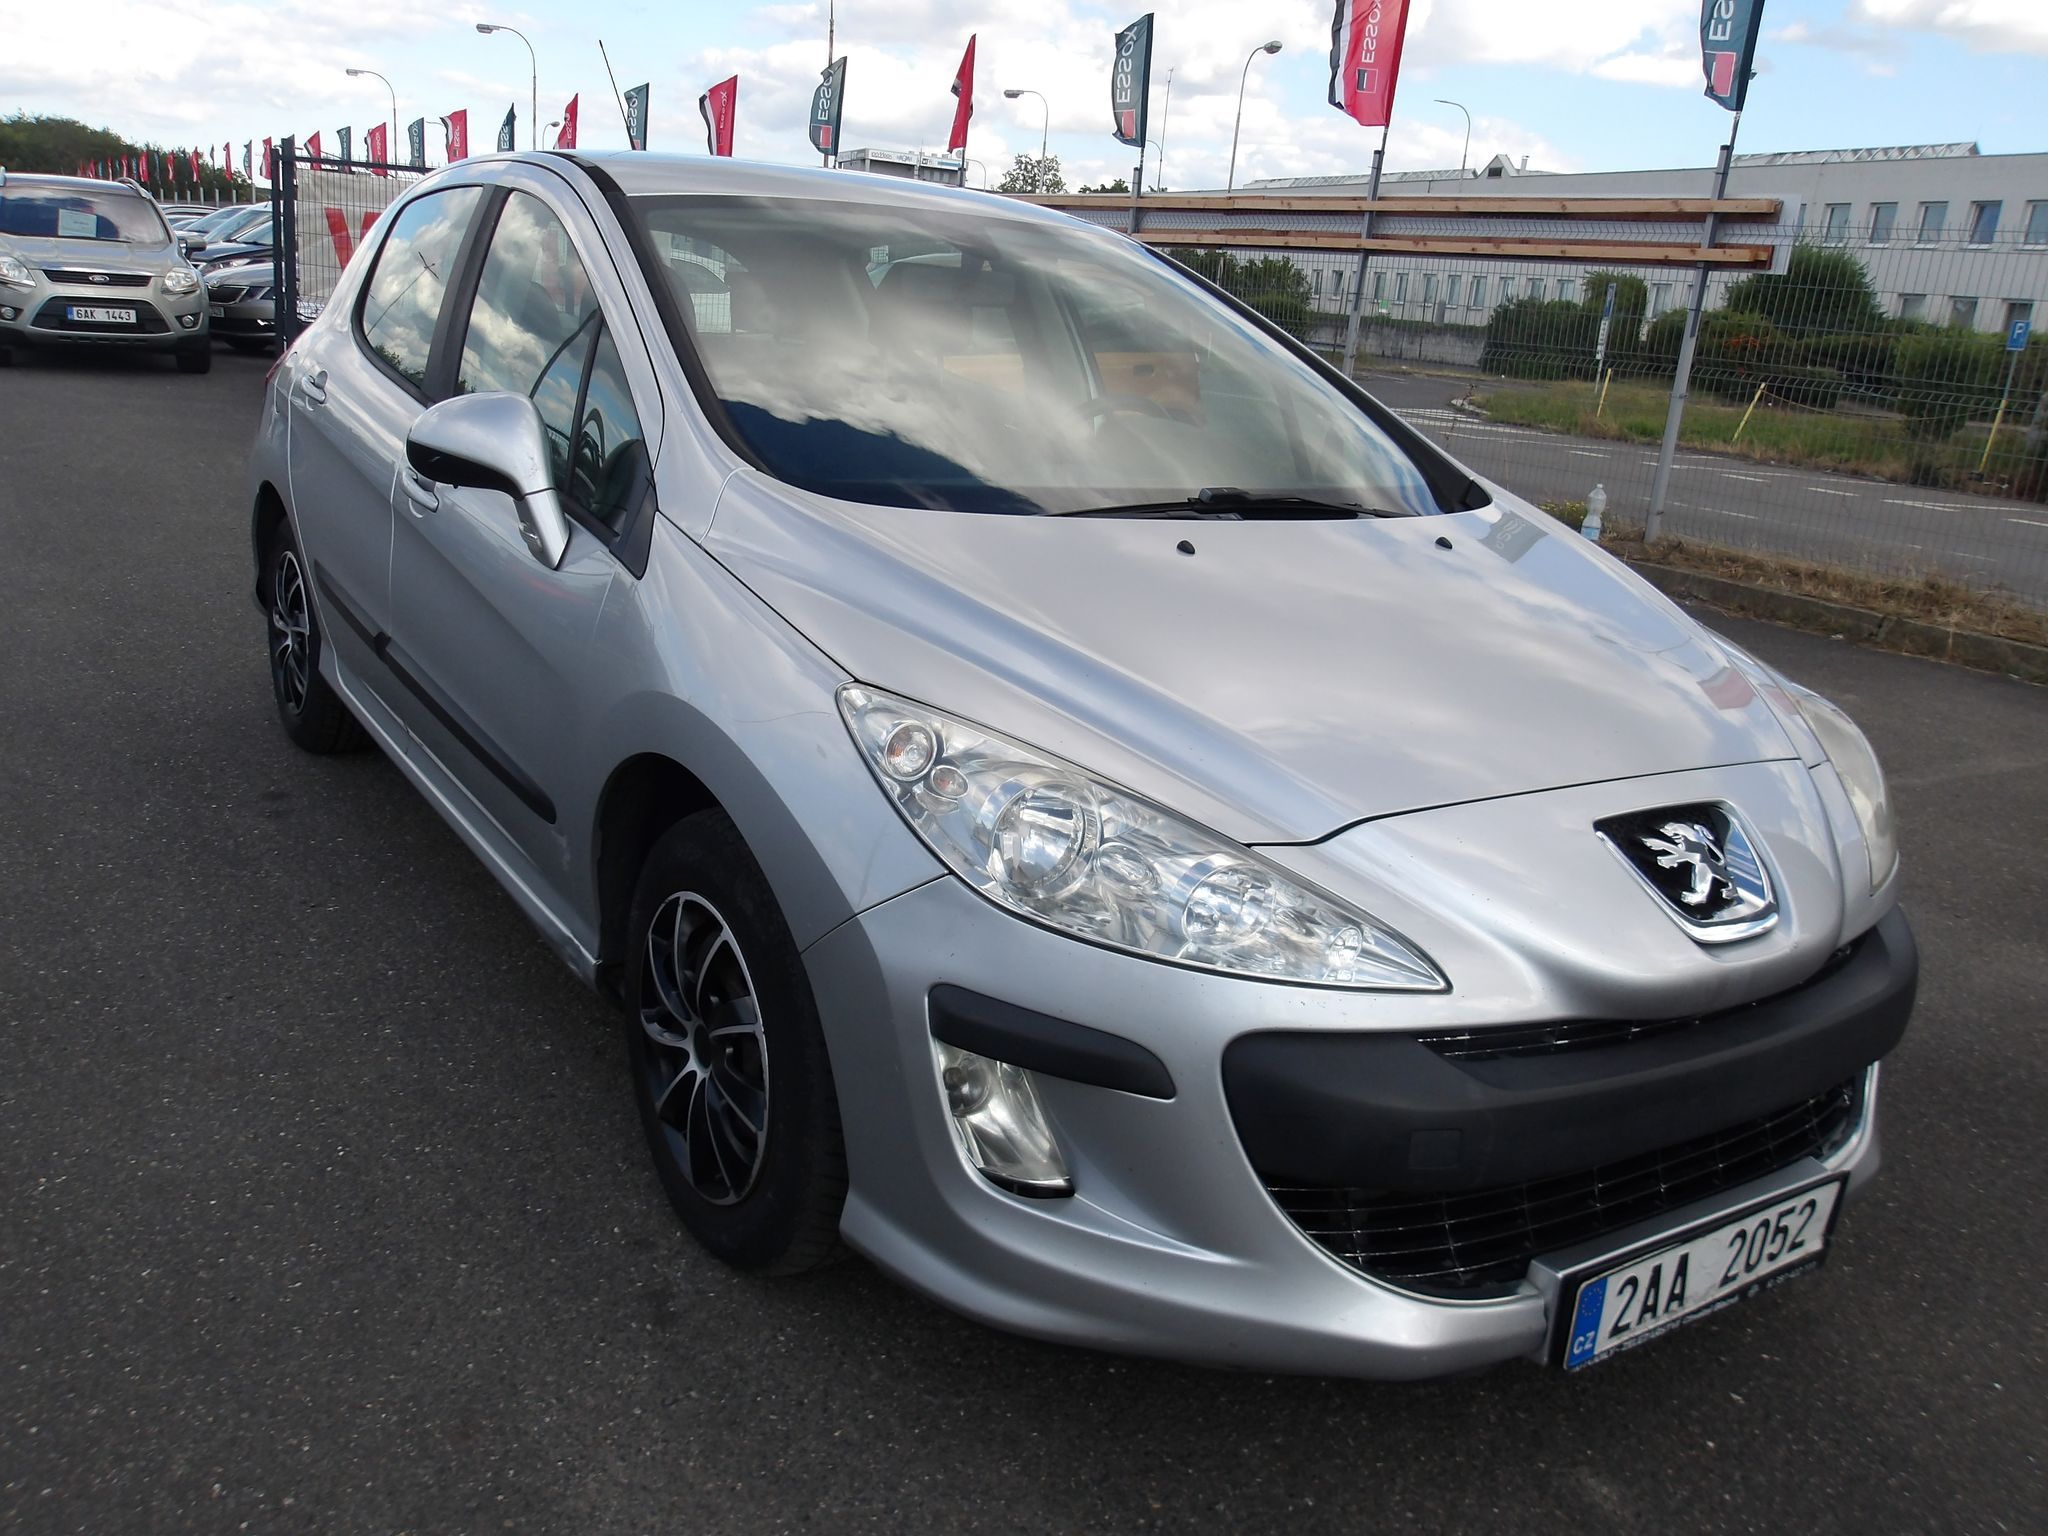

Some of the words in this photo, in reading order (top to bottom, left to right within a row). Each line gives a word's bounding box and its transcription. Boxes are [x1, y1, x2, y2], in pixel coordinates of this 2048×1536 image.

[76, 309, 96, 320] 6AK
[105, 310, 131, 321] 1443
[2012, 322, 2026, 339] P
[1608, 1252, 1689, 1339] 2AA
[1718, 1198, 1817, 1289] 2052
[1573, 1330, 1596, 1355] CZ
